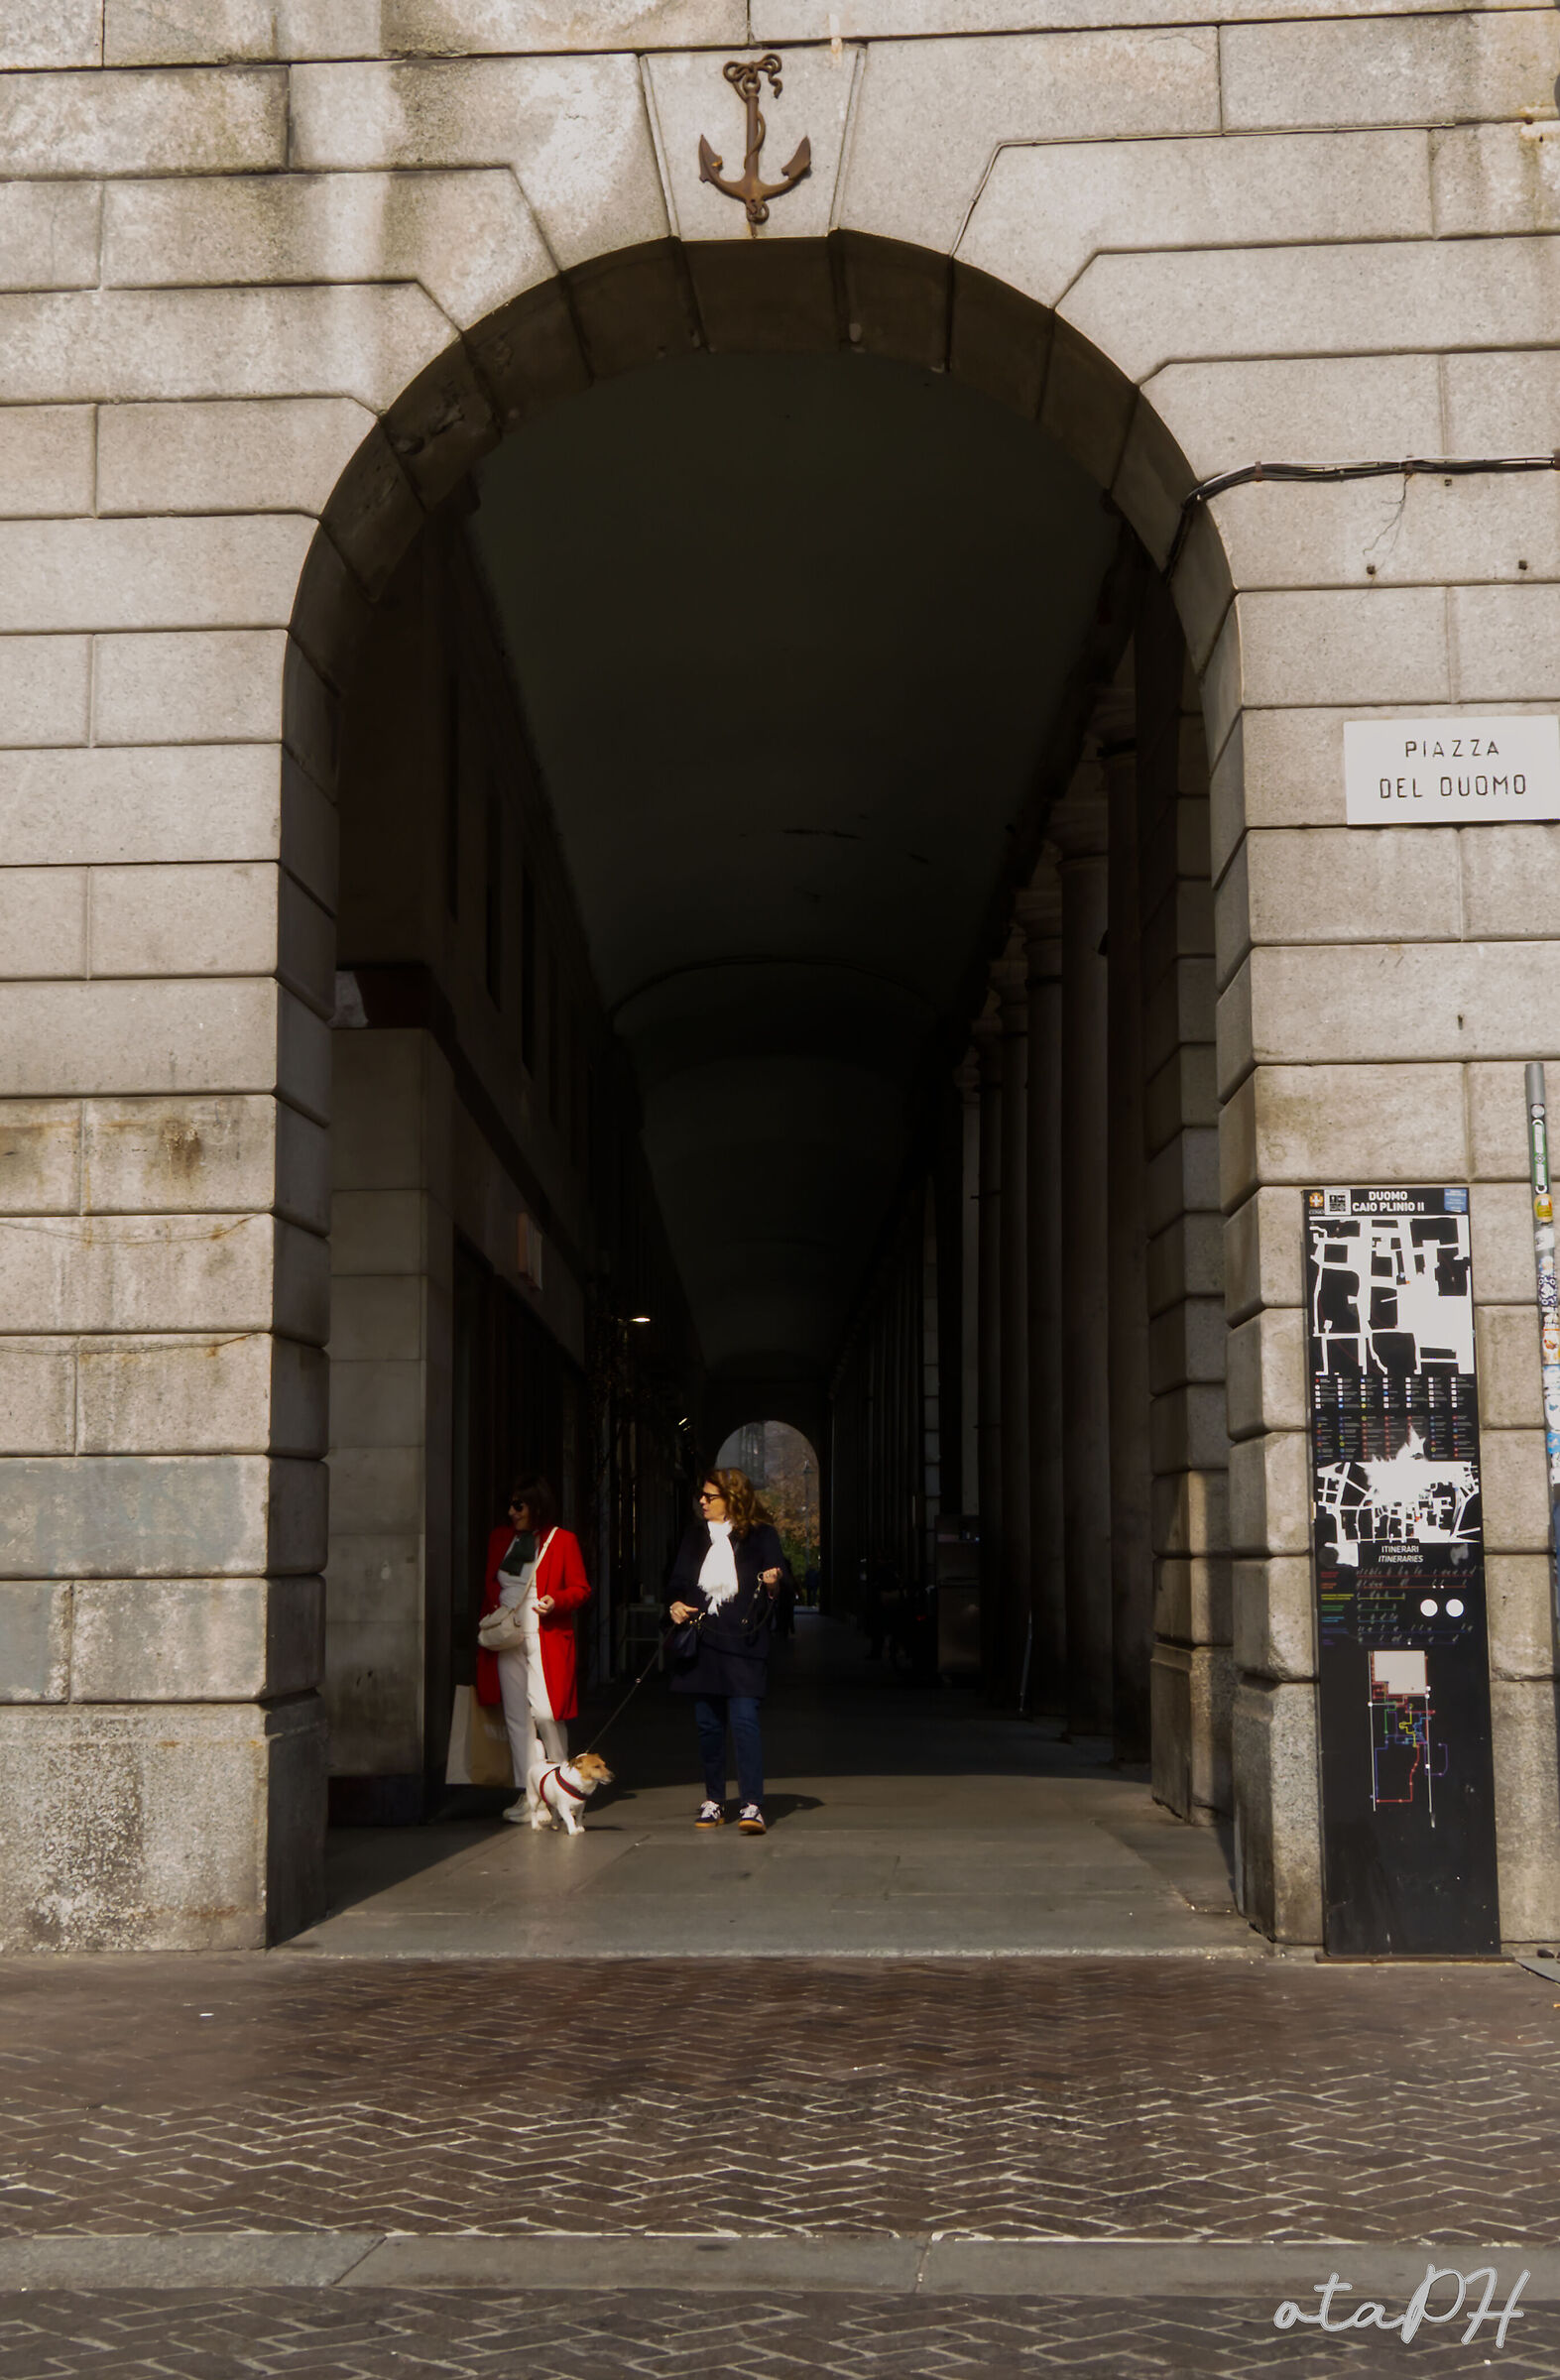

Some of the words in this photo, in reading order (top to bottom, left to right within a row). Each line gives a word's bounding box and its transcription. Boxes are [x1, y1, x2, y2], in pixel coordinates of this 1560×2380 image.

[1404, 739, 1500, 758] PIAZZA
[1379, 777, 1423, 799] DEL
[1439, 774, 1526, 797] DUOMO
[1369, 1191, 1408, 1201] DUOMO
[1352, 1202, 1378, 1212] CAIO
[1380, 1202, 1415, 1212] PLINIO
[1417, 1202, 1425, 1212] II
